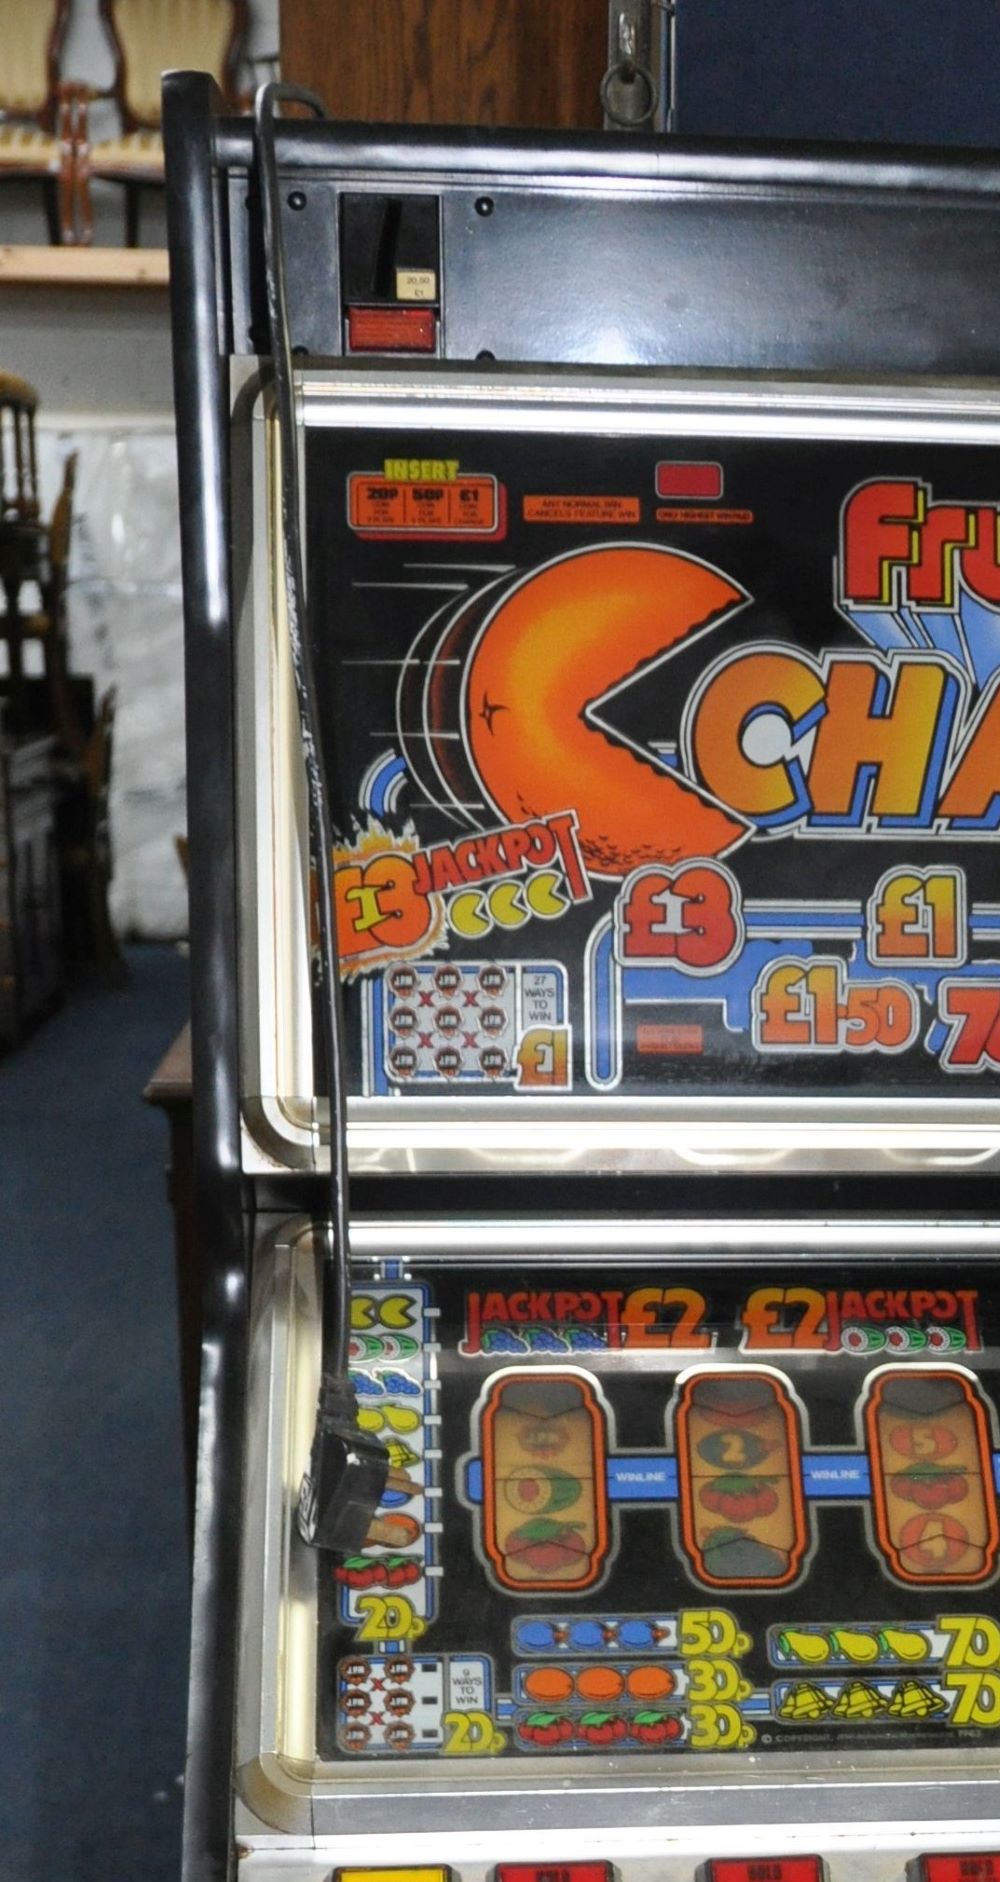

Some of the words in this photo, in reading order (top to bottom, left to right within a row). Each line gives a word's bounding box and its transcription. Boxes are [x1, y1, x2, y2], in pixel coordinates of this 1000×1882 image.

[384, 458, 460, 482] INSERT
[412, 812, 590, 903] JACKPOT
[623, 865, 738, 968] £3
[876, 874, 958, 959] £1
[525, 987, 555, 998] WAYS
[533, 975, 547, 985] 27
[529, 1011, 552, 1021] WIN
[532, 1000, 548, 1010] TO
[517, 1027, 569, 1087] £1
[465, 1290, 625, 1353] JACKPOT
[621, 1287, 710, 1350] £2
[743, 1287, 828, 1350] £2
[824, 1290, 981, 1351] JACKPOT
[911, 1428, 936, 1455] 5
[615, 1471, 666, 1483] WINLINE
[810, 1469, 860, 1480] WINLINE
[919, 1520, 947, 1559] 4
[358, 1596, 427, 1642] 20p
[452, 1677, 482, 1686] WAYS
[460, 1686, 474, 1695] TO
[455, 1696, 478, 1705] WIN
[444, 1712, 507, 1754] 20p
